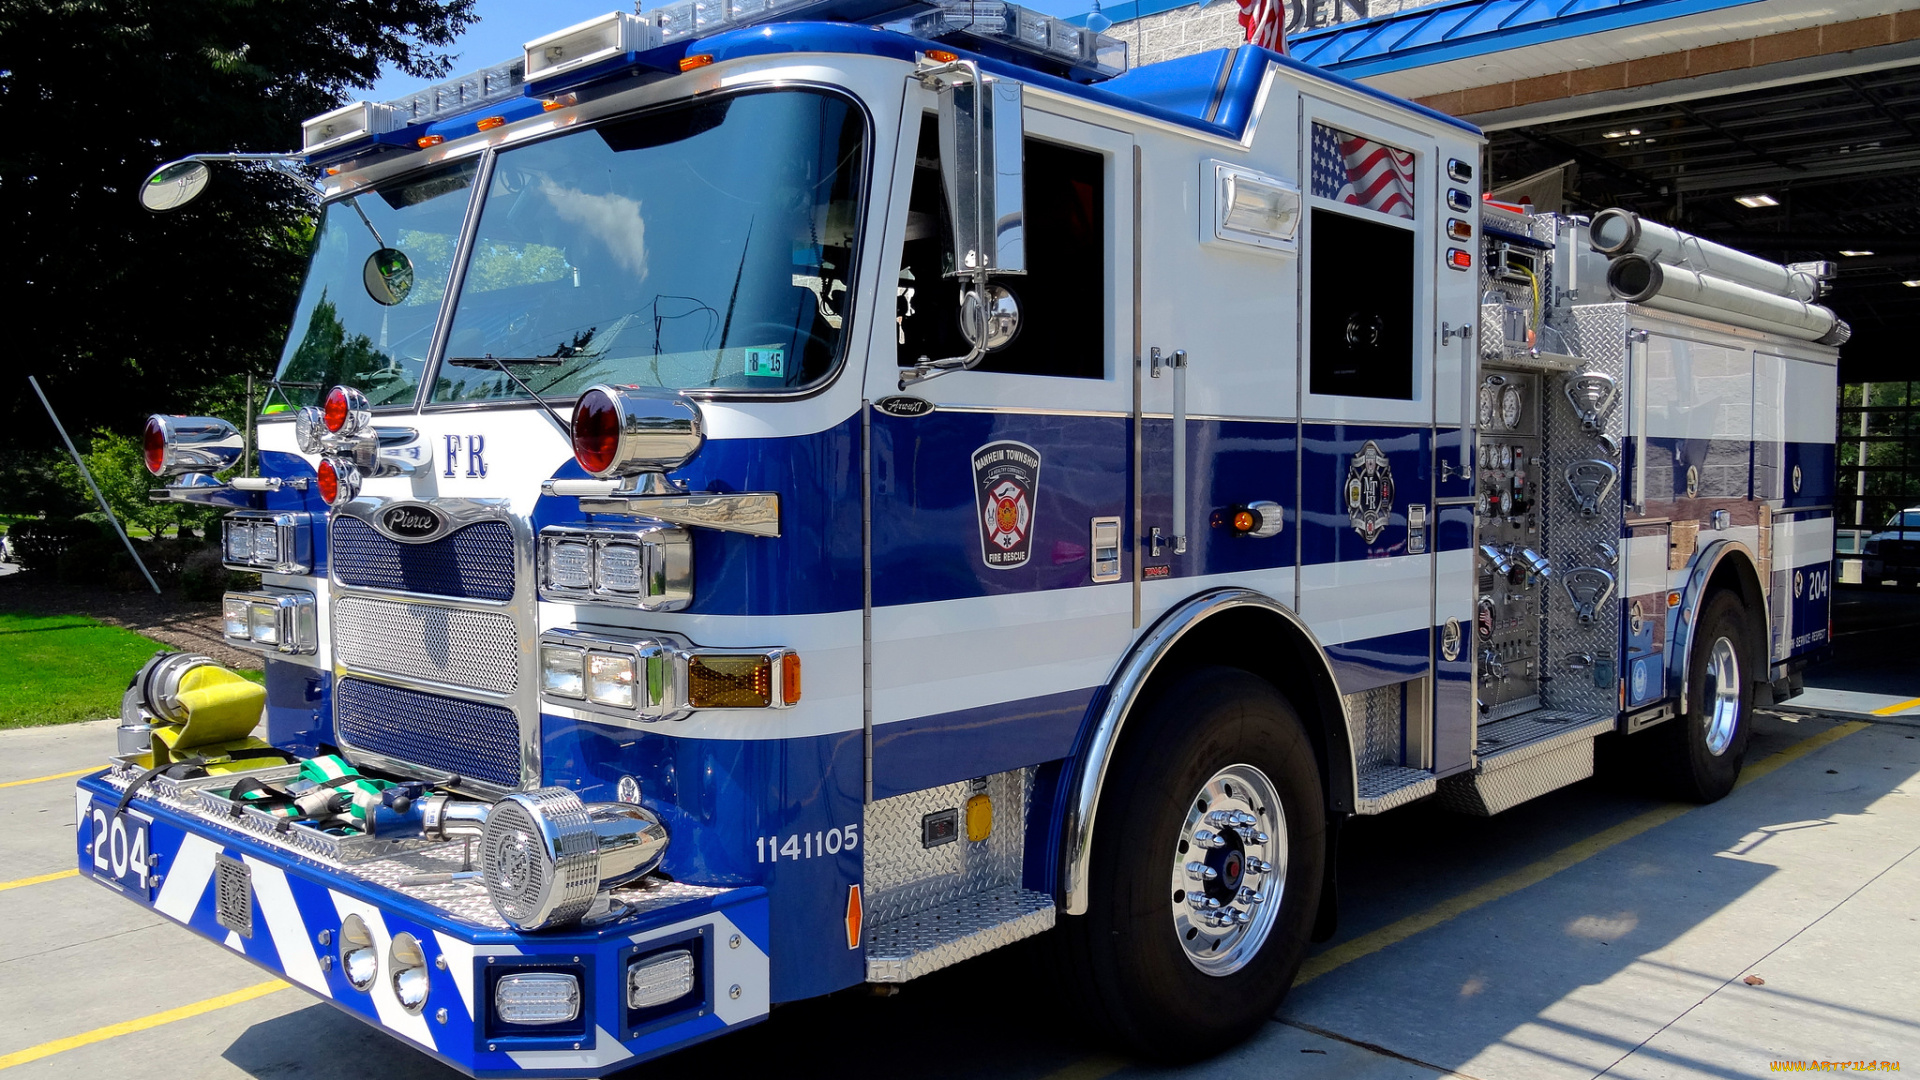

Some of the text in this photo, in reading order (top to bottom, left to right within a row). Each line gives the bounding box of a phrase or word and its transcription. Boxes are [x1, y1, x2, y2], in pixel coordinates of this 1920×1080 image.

[770, 353, 781, 372] 15
[443, 434, 488, 479] FR
[975, 449, 1038, 471] MANHEIM TOWNSHIP
[388, 508, 433, 530] Pierce
[988, 551, 1026, 563] FIRE RESCUE
[1809, 569, 1828, 601] 204
[93, 808, 149, 889] 204
[756, 823, 859, 864] 1141105
